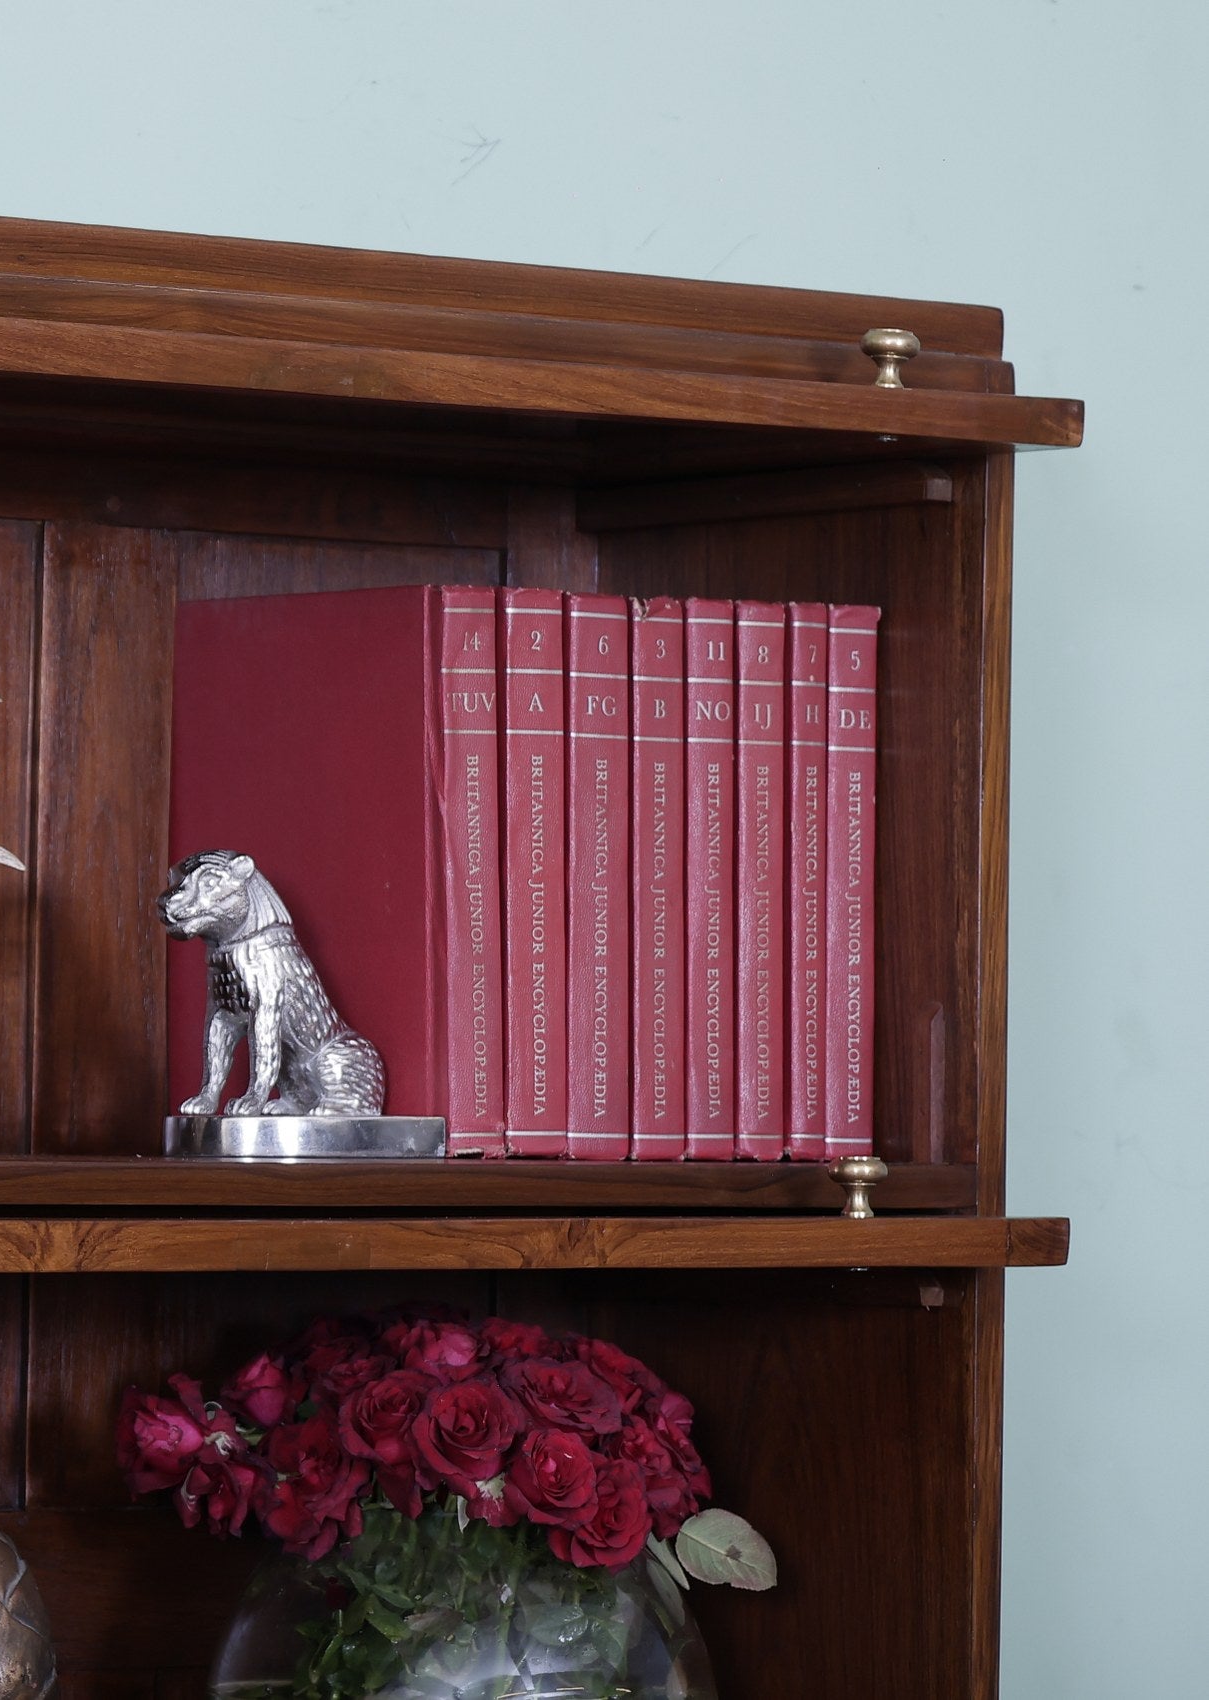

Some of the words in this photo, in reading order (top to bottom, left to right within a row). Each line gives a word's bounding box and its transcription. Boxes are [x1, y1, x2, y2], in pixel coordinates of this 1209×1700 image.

[462, 630, 481, 652] 14
[530, 630, 542, 652] 2
[598, 634, 610, 656] 6
[655, 638, 667, 660] 3
[706, 640, 726, 662] 11
[757, 645, 769, 665] 8
[808, 644, 818, 665] 7
[850, 650, 862, 671] 5
[447, 692, 496, 713] TUV
[527, 692, 545, 713] A
[586, 695, 617, 717] FG
[653, 699, 667, 719] B
[694, 700, 732, 722] NO
[752, 703, 773, 730] IJ
[805, 704, 820, 725] H
[838, 708, 872, 731] DE
[465, 753, 482, 876] BRITANNICA
[528, 753, 544, 876] BRITANNICA
[594, 758, 608, 878] BRITANNICA
[652, 760, 667, 880] BRITANNICA
[706, 762, 721, 881] BRITANNICA
[755, 765, 770, 882] BRITANNICA
[804, 766, 819, 883] BRITANNICA
[847, 771, 862, 887] BRITANNICA
[464, 880, 484, 955] JUNIOR
[527, 879, 544, 954] JUNIOR
[591, 882, 608, 957] JUNIOR
[650, 884, 666, 960] JUNIOR
[704, 885, 720, 961] JUNIOR
[752, 886, 770, 961] JUNIOR
[802, 886, 818, 961] JUNIOR
[844, 891, 862, 967] JUNIOR
